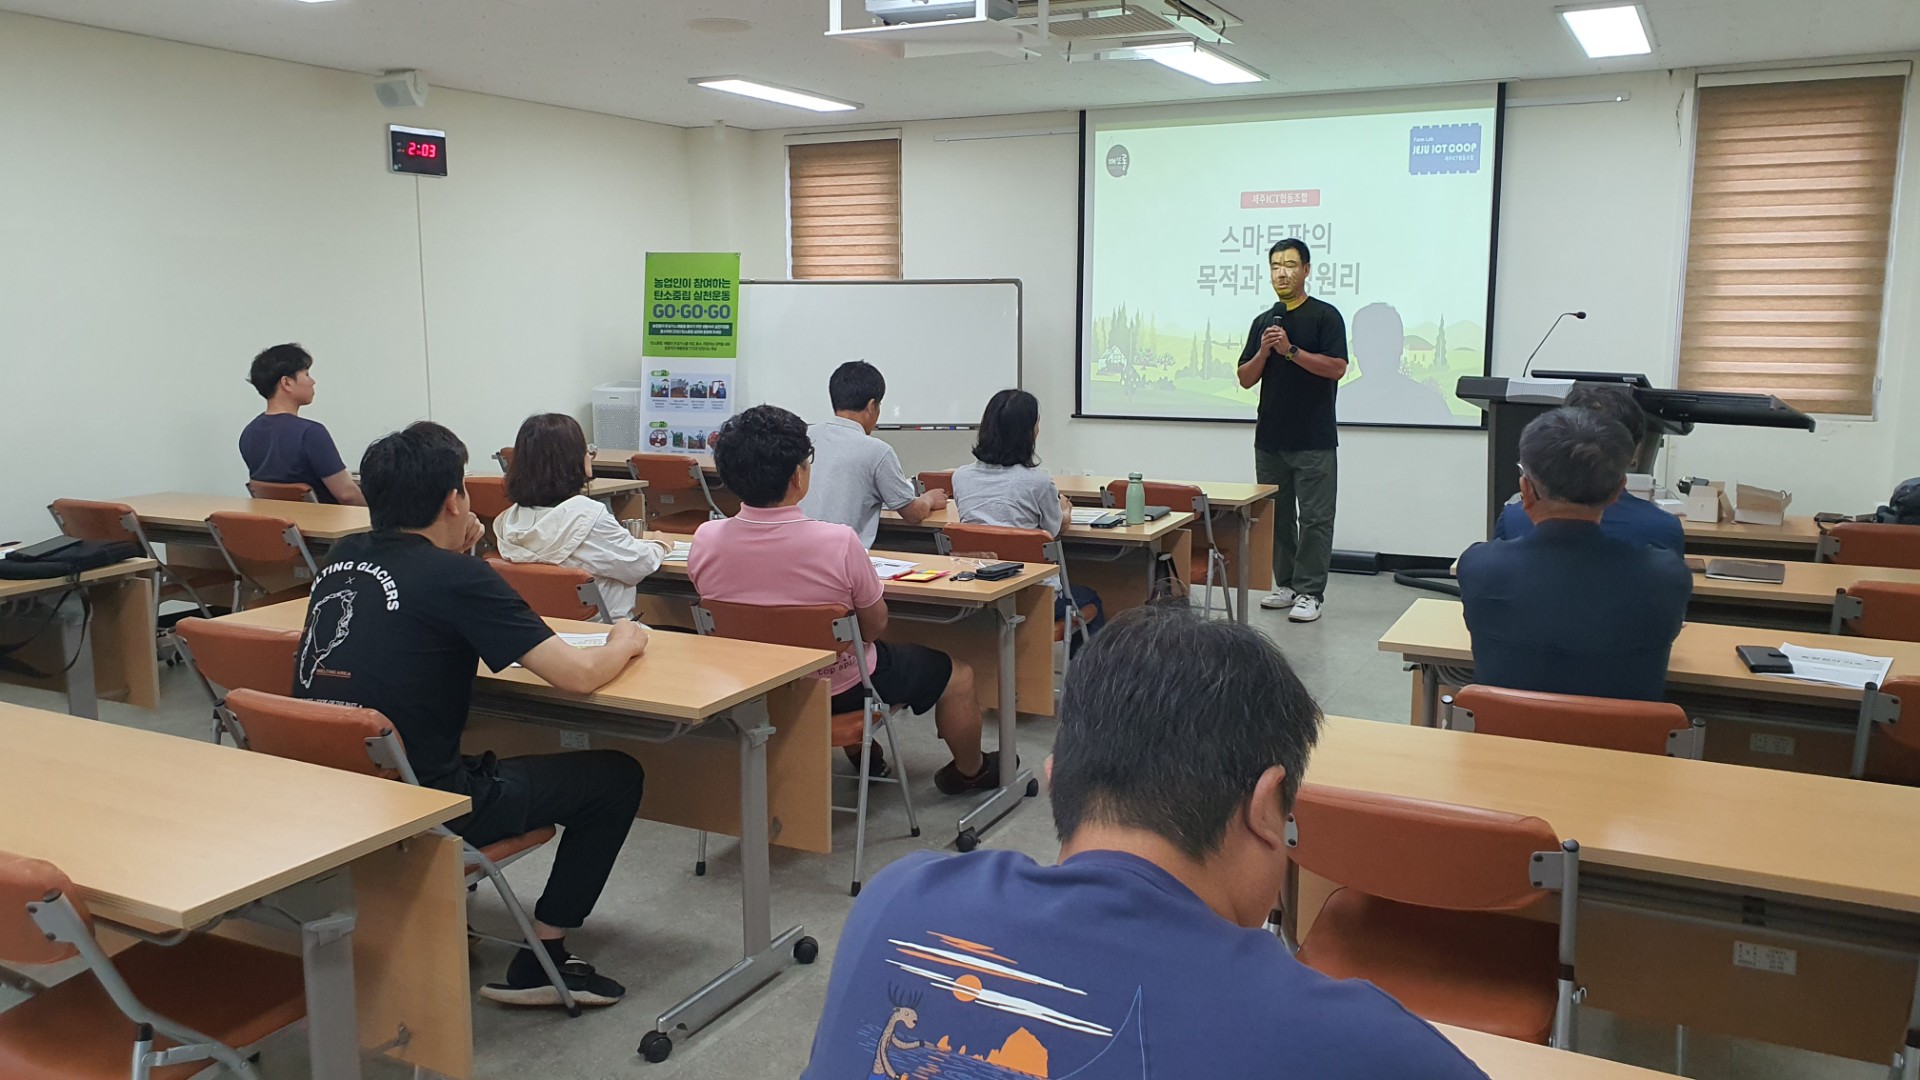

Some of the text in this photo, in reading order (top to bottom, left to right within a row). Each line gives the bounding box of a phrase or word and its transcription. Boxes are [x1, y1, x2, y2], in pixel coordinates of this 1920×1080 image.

[407, 142, 436, 158] 2:03
[1412, 145, 1430, 155] JEJU
[1448, 142, 1477, 153] COOP
[1252, 192, 1308, 204] 제주ICT협동조합
[654, 277, 731, 289] 농업인이 참여하는
[1197, 263, 1263, 296] 목적과
[653, 289, 730, 301] 탄소중립 실천운동
[357, 561, 400, 612] GLACIERS
[818, 666, 835, 676] top
